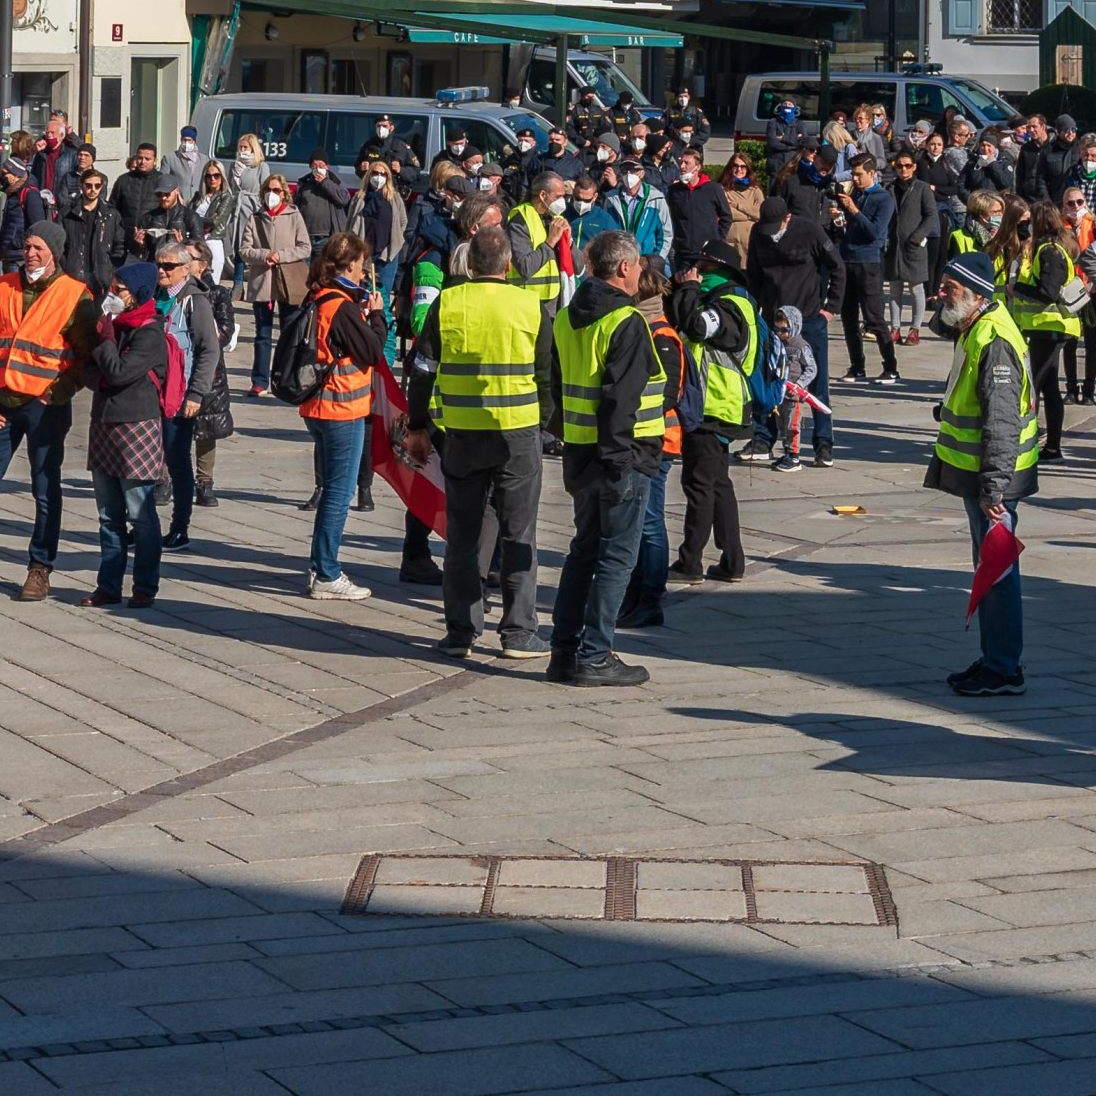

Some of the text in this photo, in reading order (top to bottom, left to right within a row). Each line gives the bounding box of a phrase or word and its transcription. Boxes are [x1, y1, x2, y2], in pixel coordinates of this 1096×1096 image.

[115, 25, 121, 36] 9
[628, 36, 645, 46] BAR
[263, 142, 287, 157] 133
